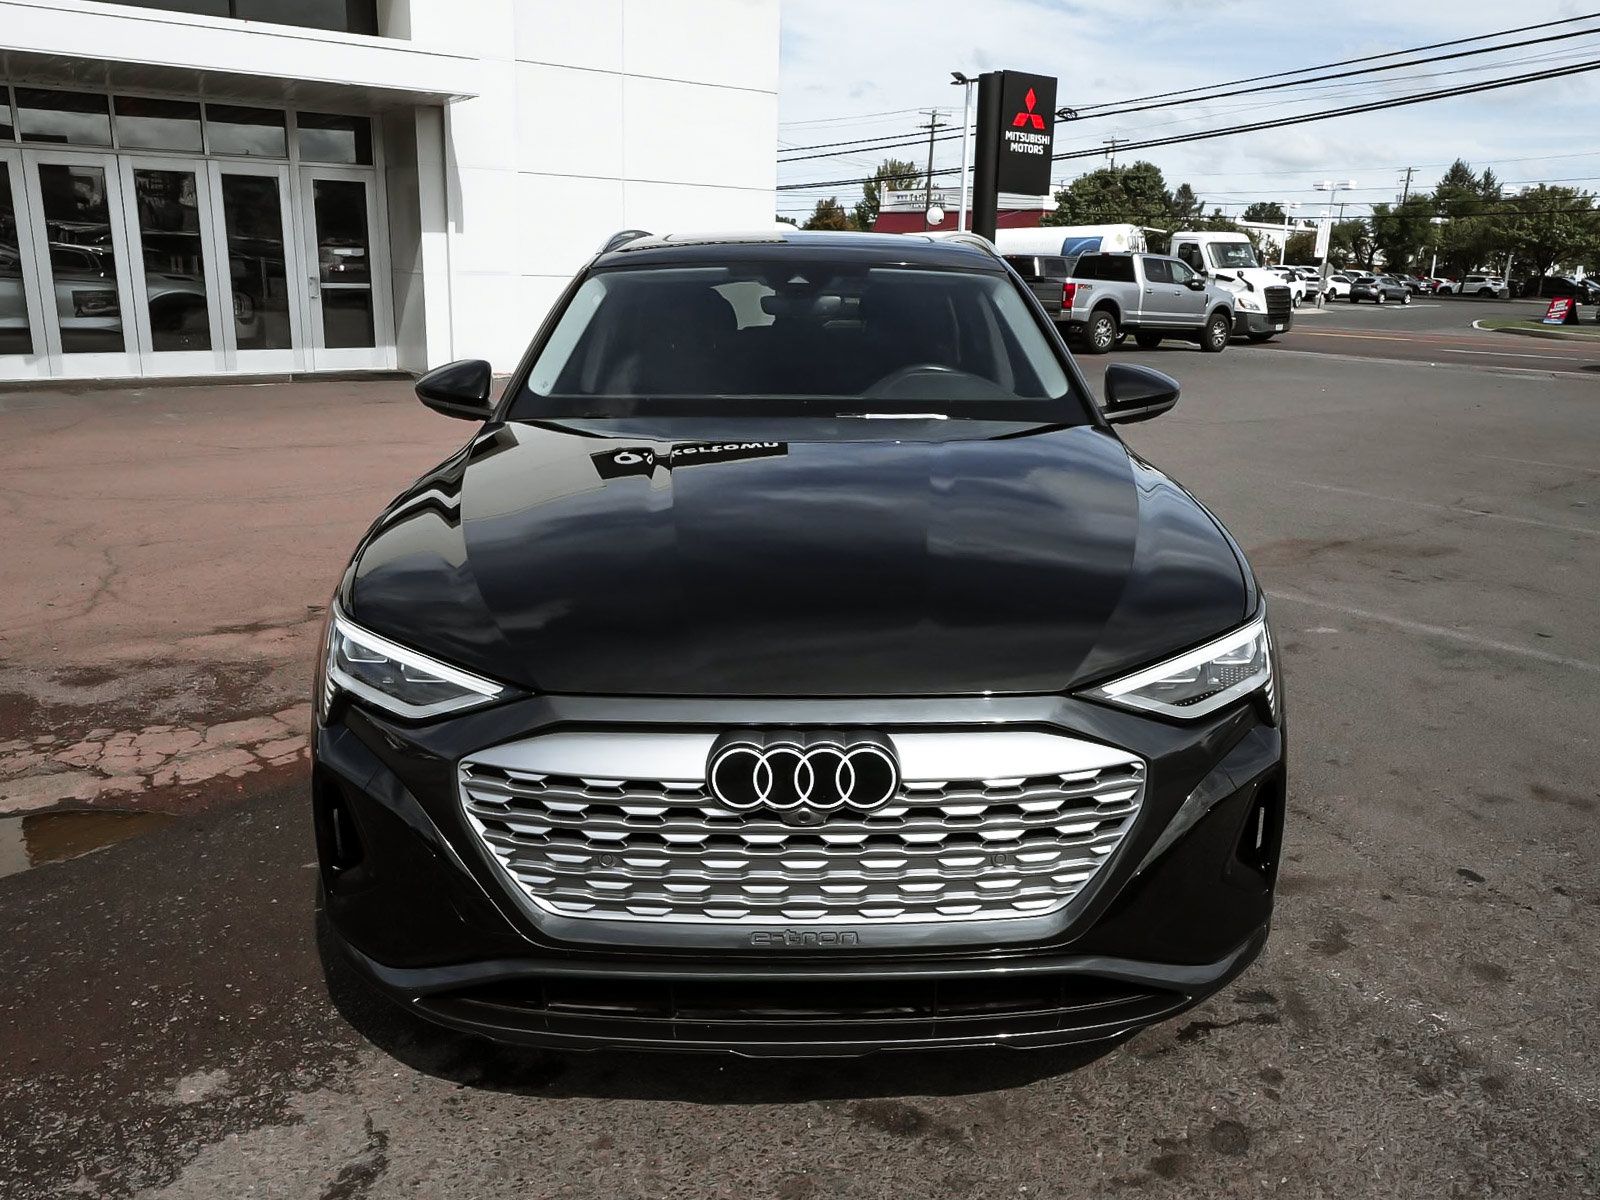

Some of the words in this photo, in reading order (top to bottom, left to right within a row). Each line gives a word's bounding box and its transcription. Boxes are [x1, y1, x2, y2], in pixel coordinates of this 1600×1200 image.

[1005, 130, 1050, 145] MITSUBISHI
[1010, 142, 1044, 155] MOTORS
[751, 929, 859, 946] e-tron
